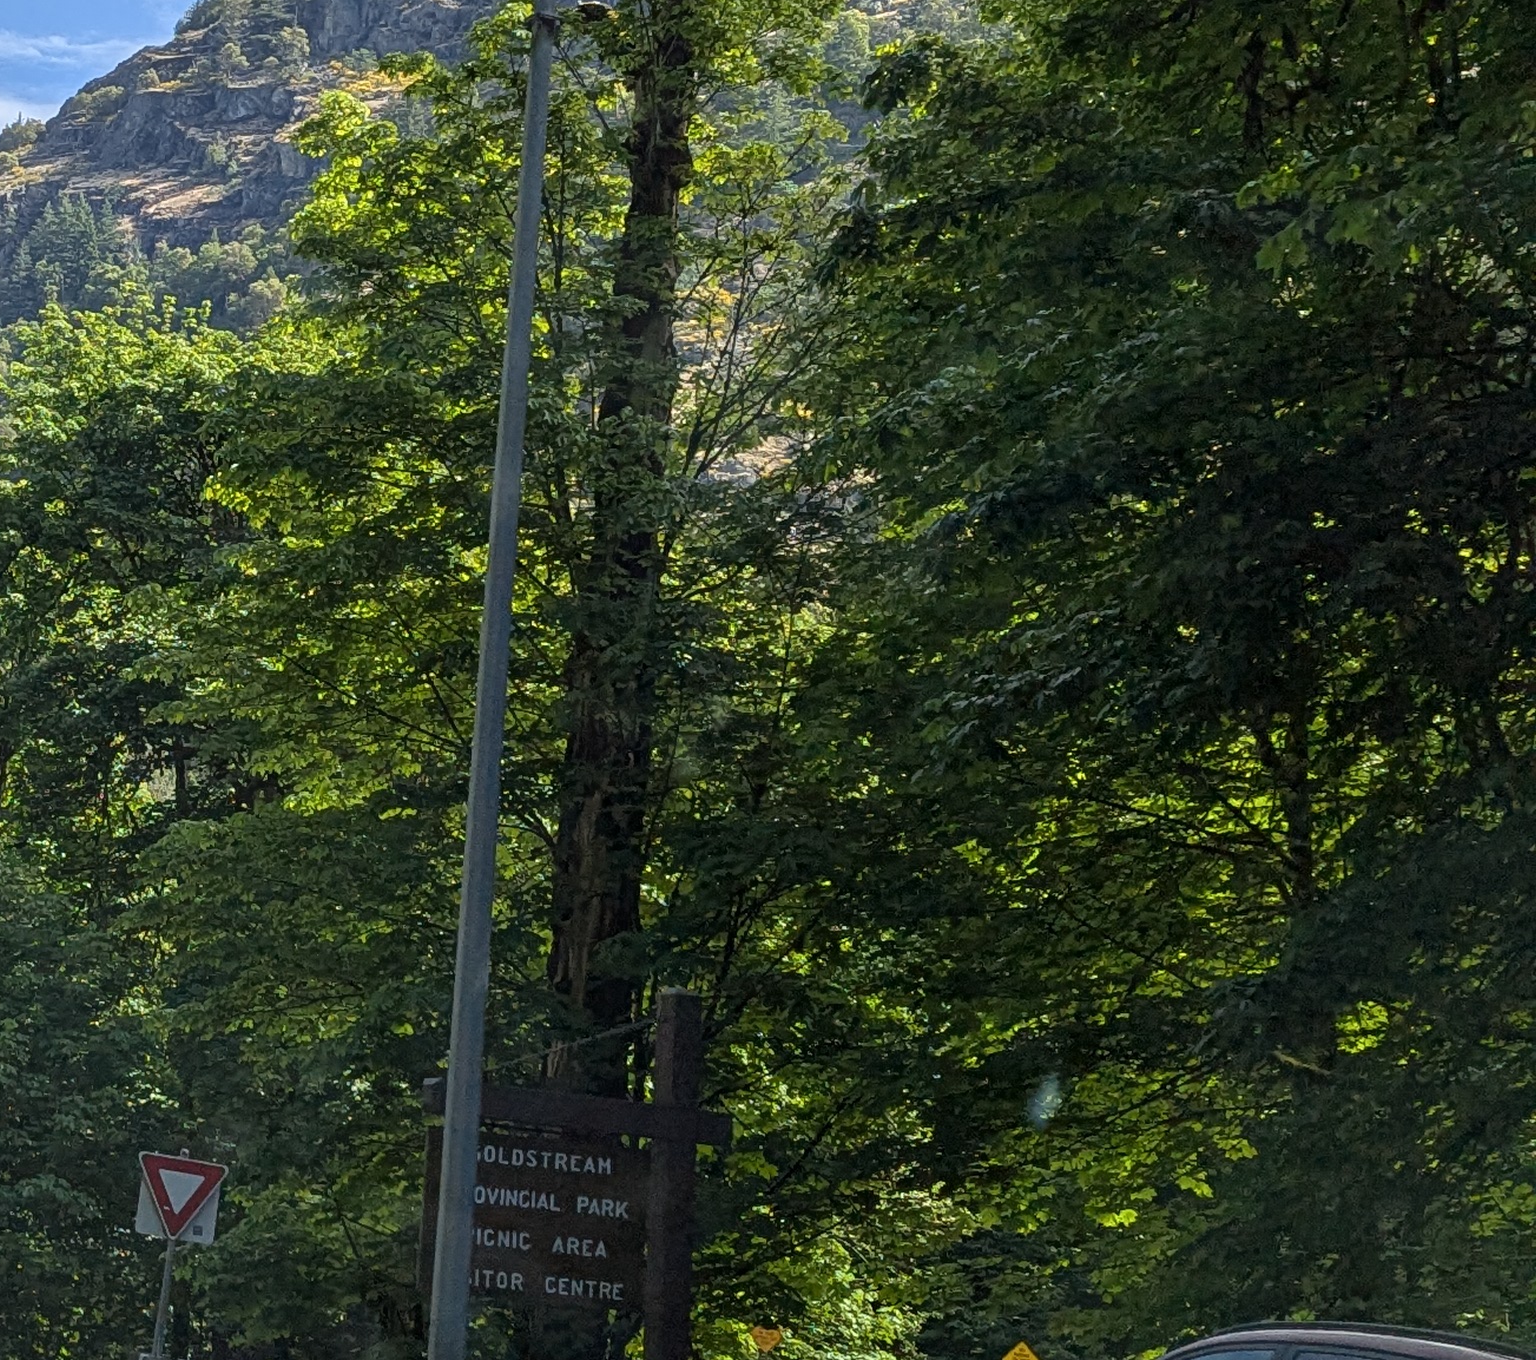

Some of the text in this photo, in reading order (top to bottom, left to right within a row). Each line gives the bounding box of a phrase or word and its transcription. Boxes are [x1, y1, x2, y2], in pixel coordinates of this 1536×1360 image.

[474, 1185, 629, 1219] OVINCIAL PARK
[471, 1228, 607, 1258] ICNIC AREA
[469, 1268, 624, 1301] ITOR CENTRE
